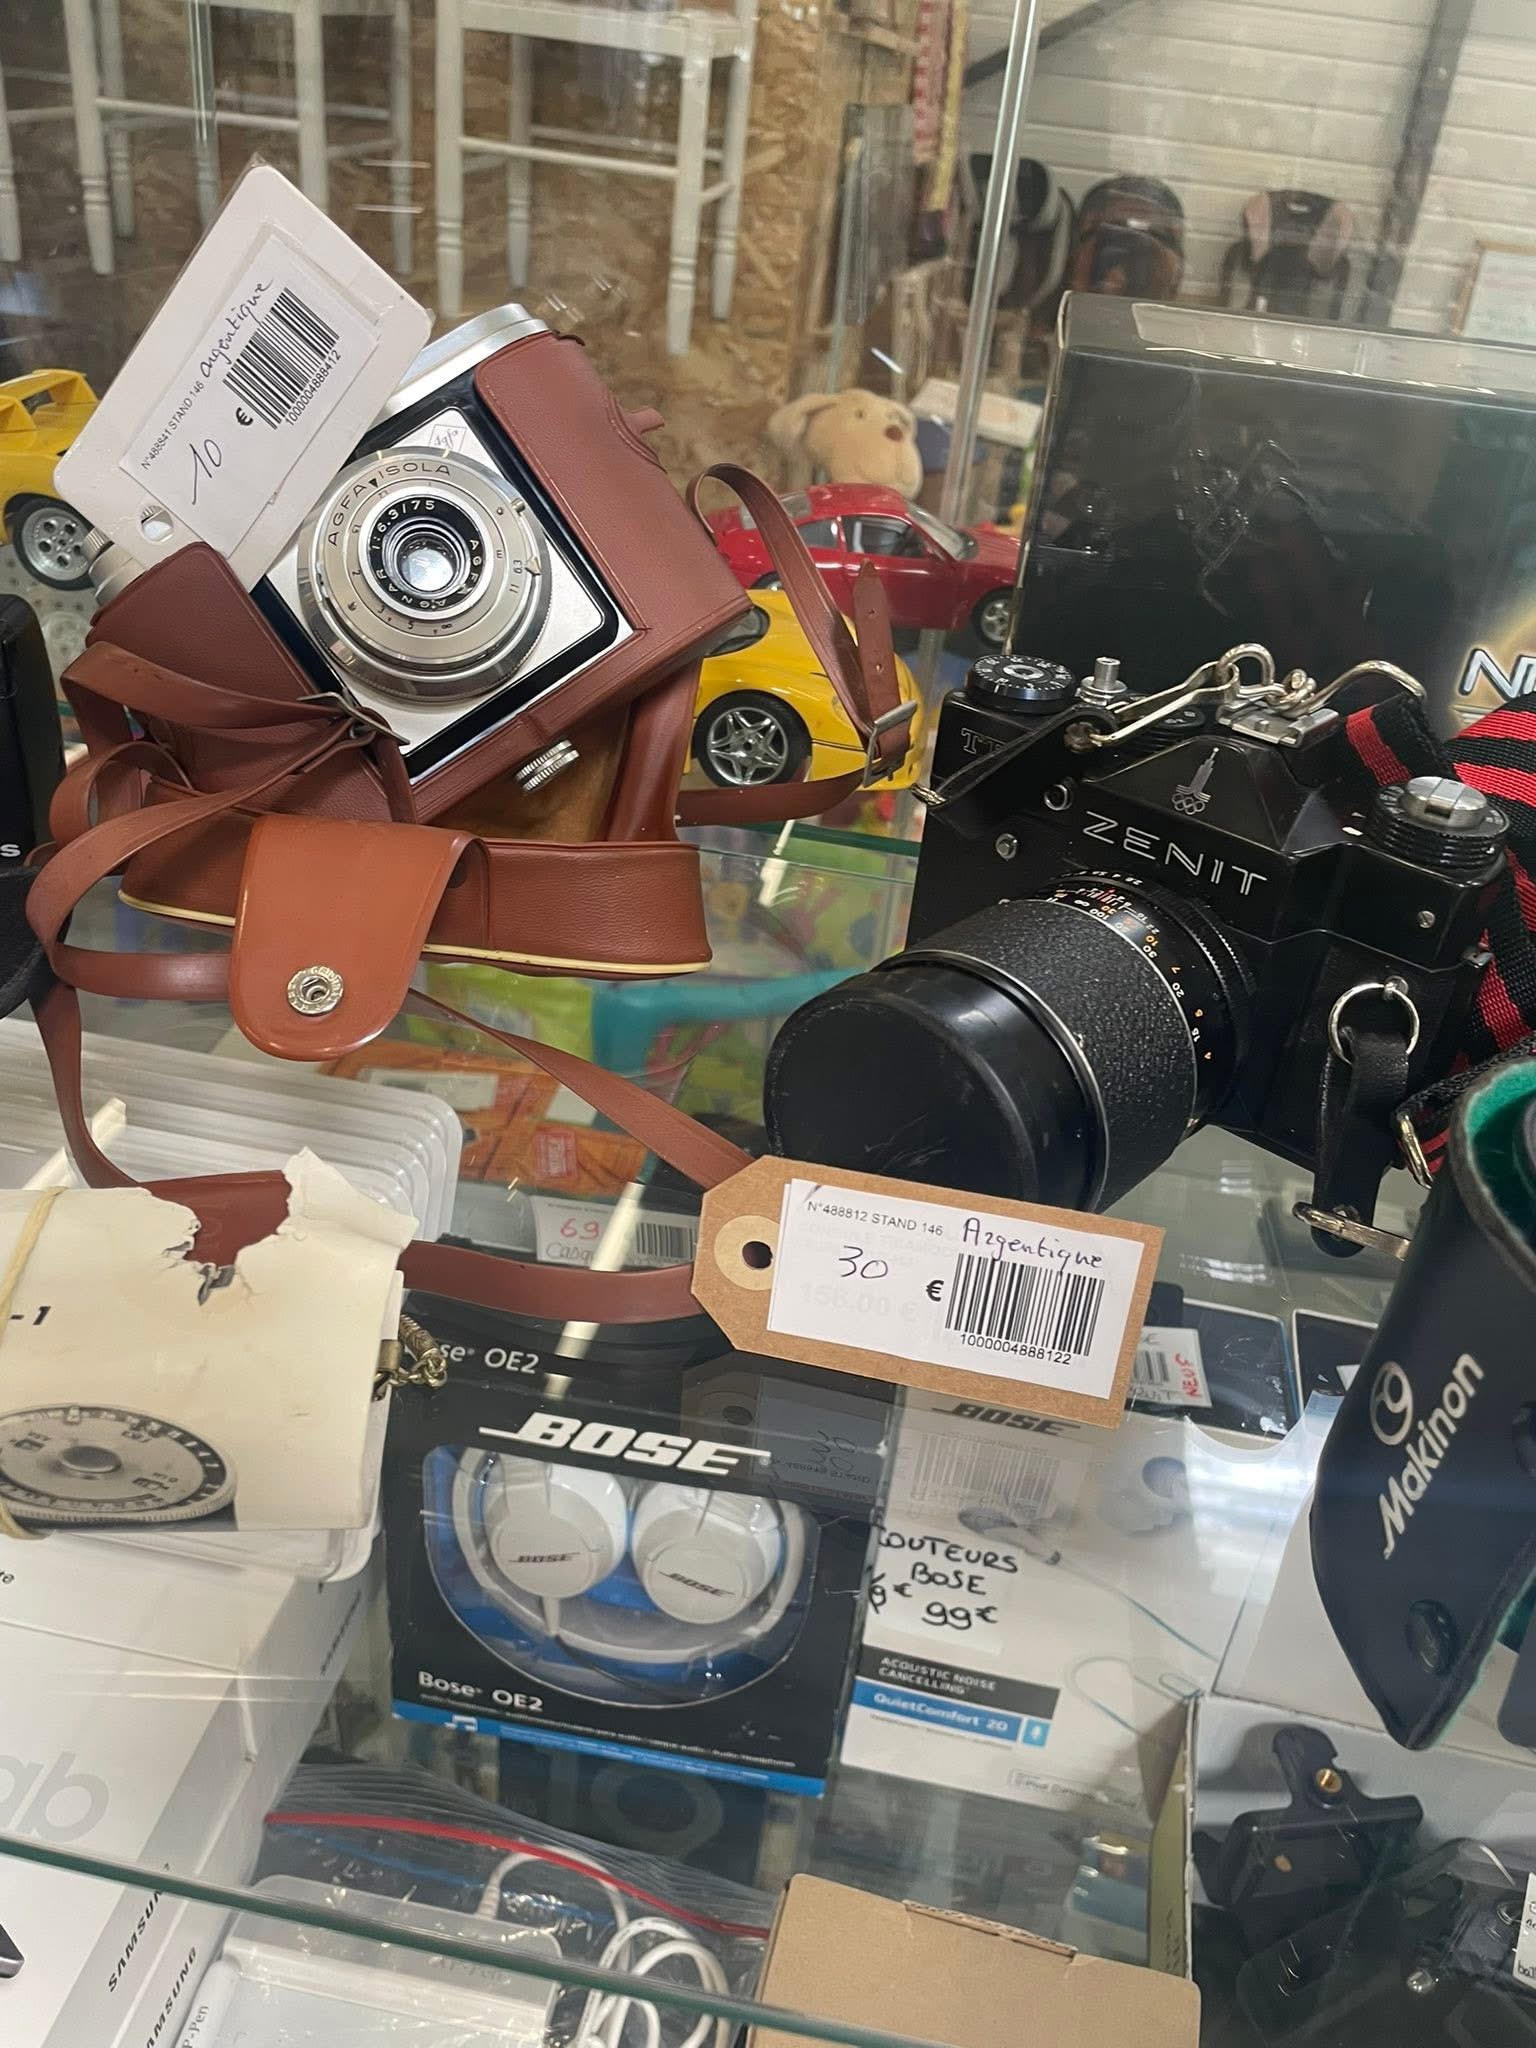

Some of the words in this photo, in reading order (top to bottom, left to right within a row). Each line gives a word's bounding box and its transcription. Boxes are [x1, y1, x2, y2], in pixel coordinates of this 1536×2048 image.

[169, 398, 194, 430] STAND
[190, 380, 205, 402] 146
[285, 349, 342, 426] 1000004888412
[190, 438, 223, 506] 10
[235, 407, 253, 427] €
[327, 482, 367, 547] AGFA
[377, 461, 451, 480] ISOLA
[1083, 811, 1268, 896] ZENIT
[1172, 982, 1185, 999] 20
[807, 1200, 868, 1223] N°488812
[871, 1212, 917, 1232] STAND
[921, 1222, 944, 1237] 146
[838, 1245, 889, 1280] 30
[925, 1279, 945, 1302] €
[484, 1347, 539, 1375] OE2
[960, 1333, 1073, 1366] 1000004888122
[932, 1403, 1081, 1436] BOSE
[479, 1411, 772, 1476] BOSE
[1379, 1353, 1485, 1561] Makinon
[508, 1552, 581, 1563] BOSE
[911, 1562, 986, 1595] BOSE
[659, 1571, 738, 1598] BOSE
[418, 1670, 474, 1697] Bose
[492, 1688, 543, 1712] OE2
[880, 1656, 950, 1681] ACOUSTIC
[953, 1673, 996, 1691] NOISE
[873, 1691, 979, 1727] QuietComfort
[986, 1715, 1008, 1732] 20
[0, 1751, 110, 1842] ab
[146, 1946, 197, 2048] AMSUNG
